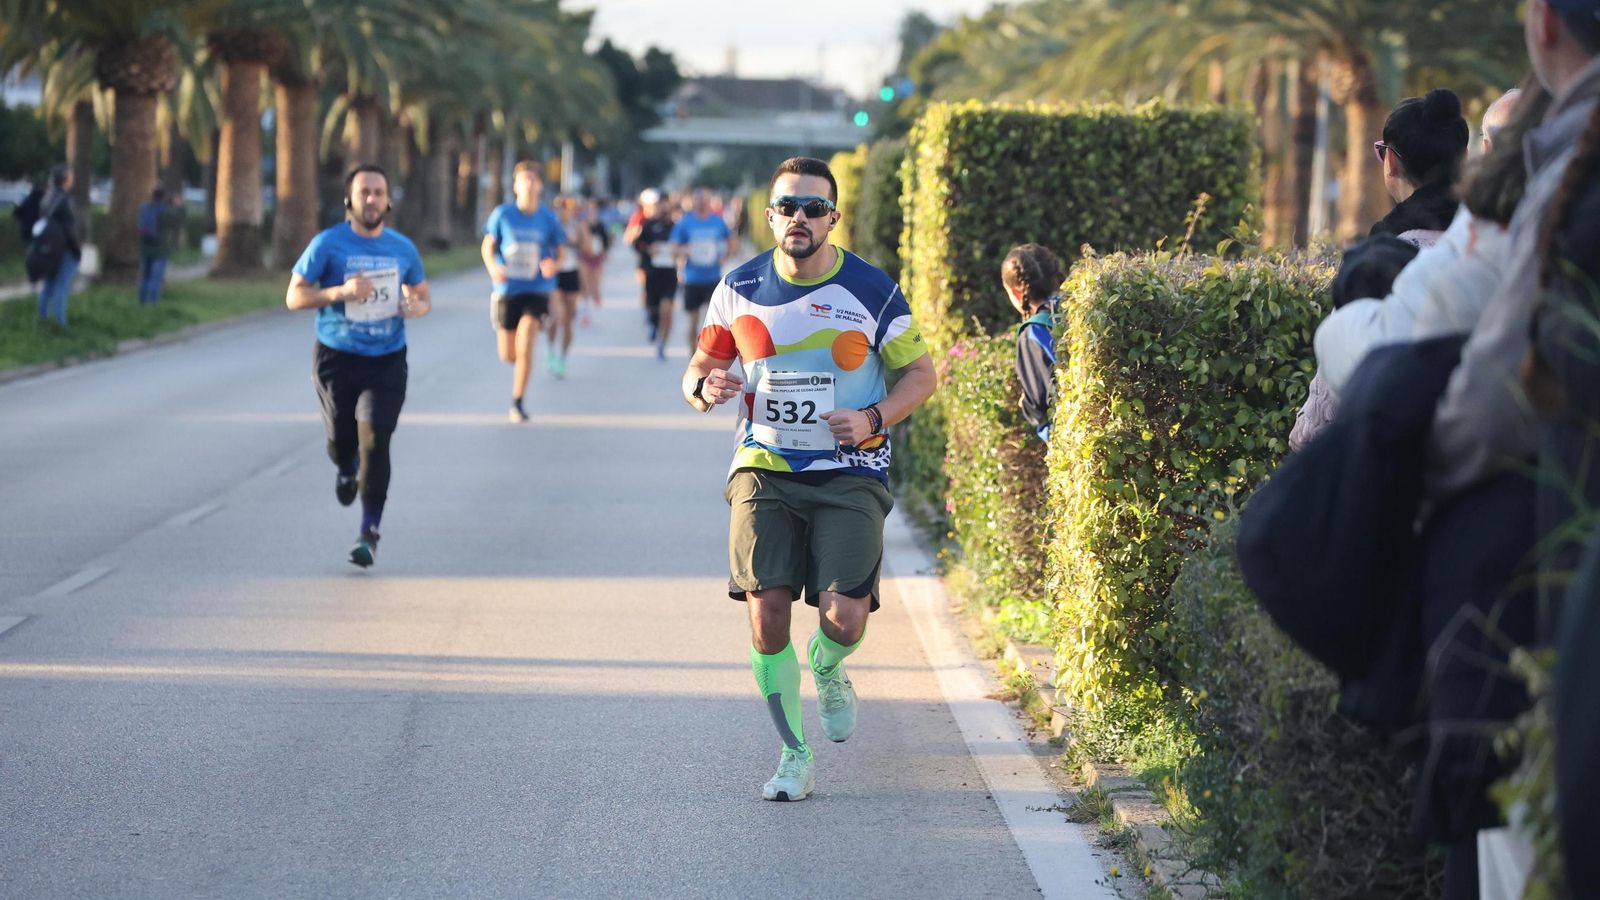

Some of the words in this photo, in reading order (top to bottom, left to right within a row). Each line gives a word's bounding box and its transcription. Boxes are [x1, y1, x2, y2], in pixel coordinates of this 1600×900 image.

[842, 314, 863, 324] MÁLAGA
[844, 309, 867, 320] MARATÓN
[766, 398, 817, 424] 532
